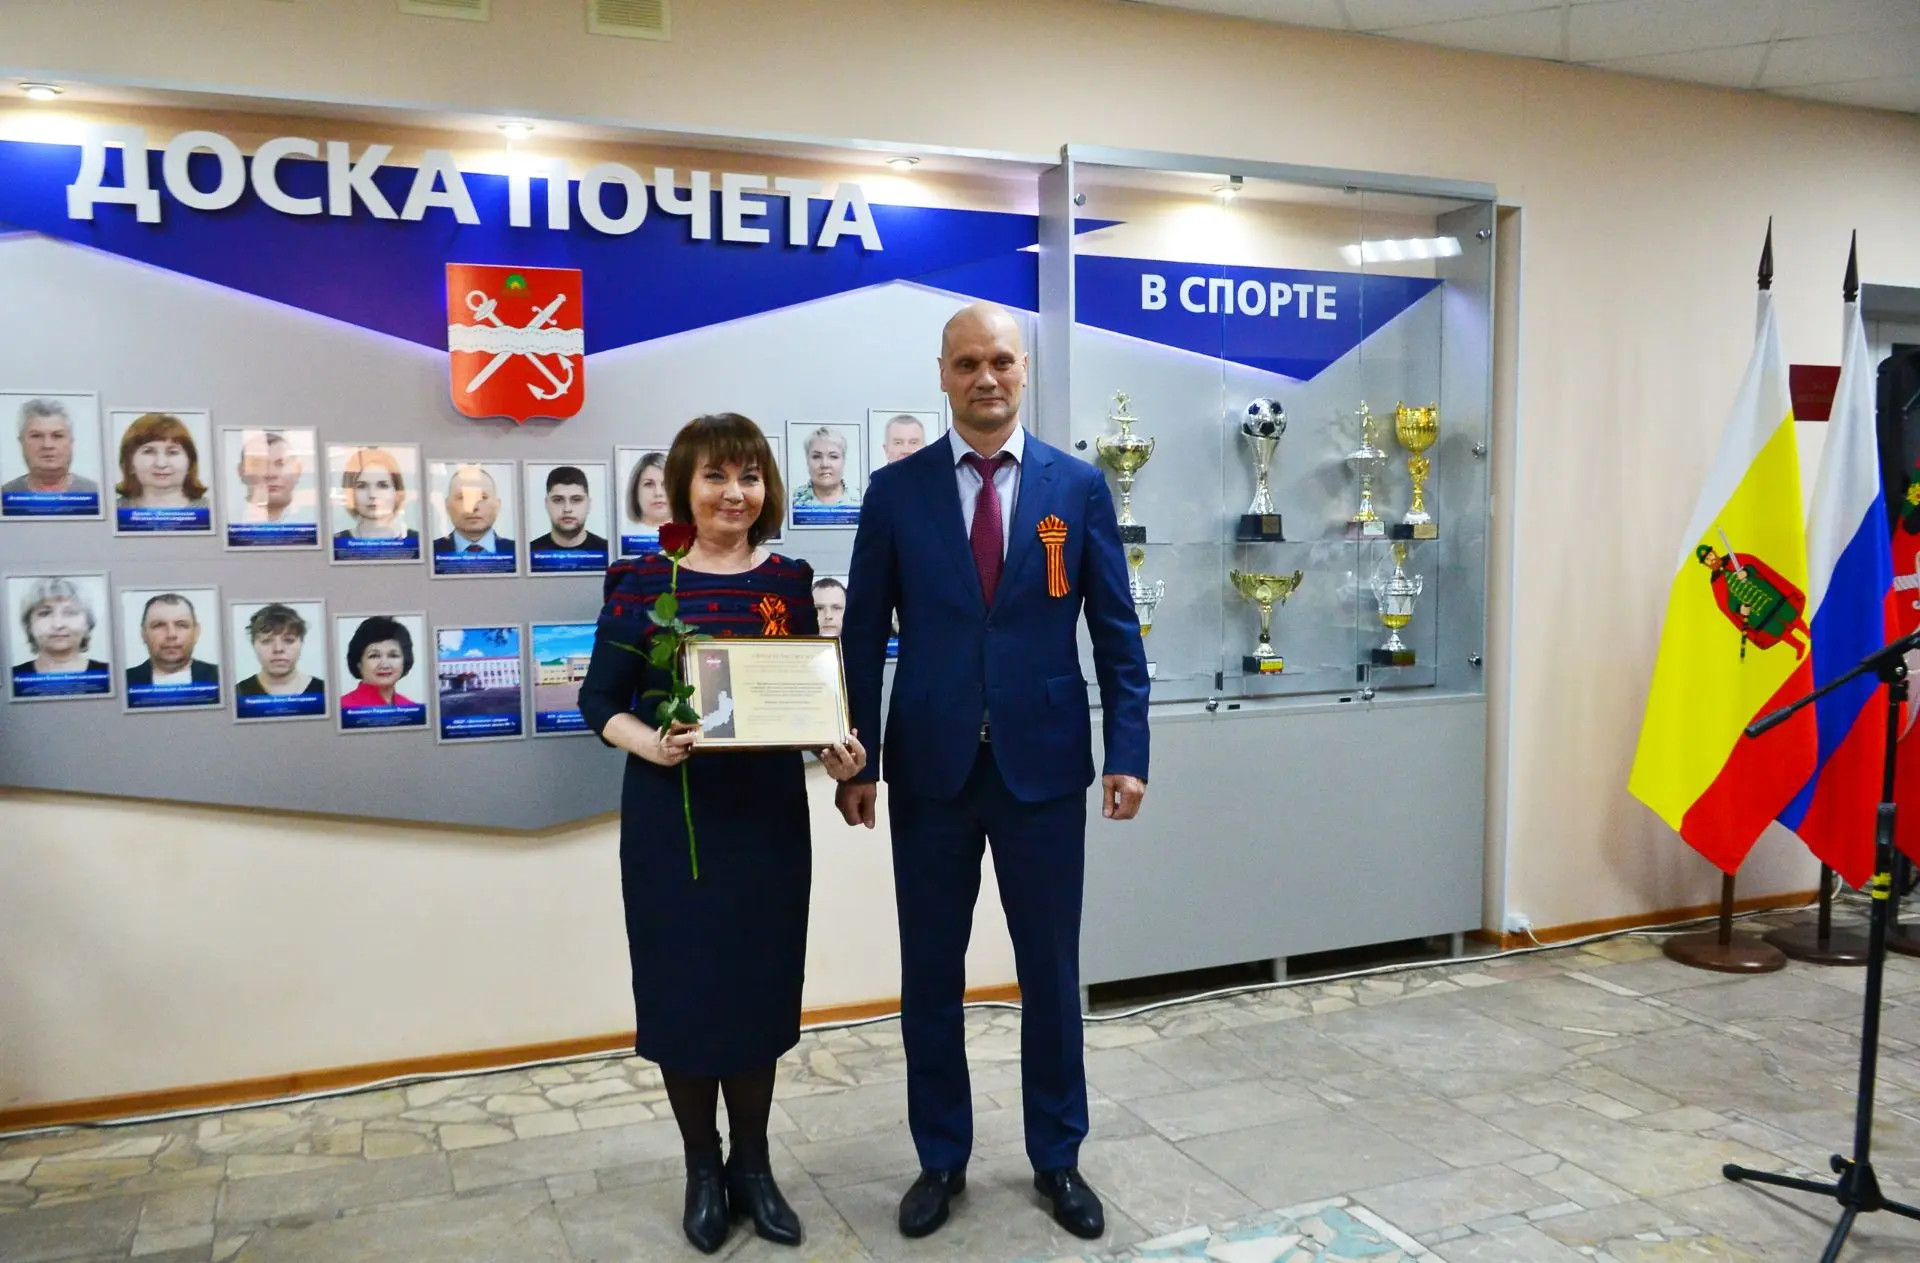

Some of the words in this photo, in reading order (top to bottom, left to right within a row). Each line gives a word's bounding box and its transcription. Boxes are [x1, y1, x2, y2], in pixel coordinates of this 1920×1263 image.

[66, 126, 481, 226] ДОСКА
[508, 159, 883, 251] ПОЧЕТА
[1140, 273, 1167, 311] В
[1179, 276, 1337, 320] СПОРТЕ
